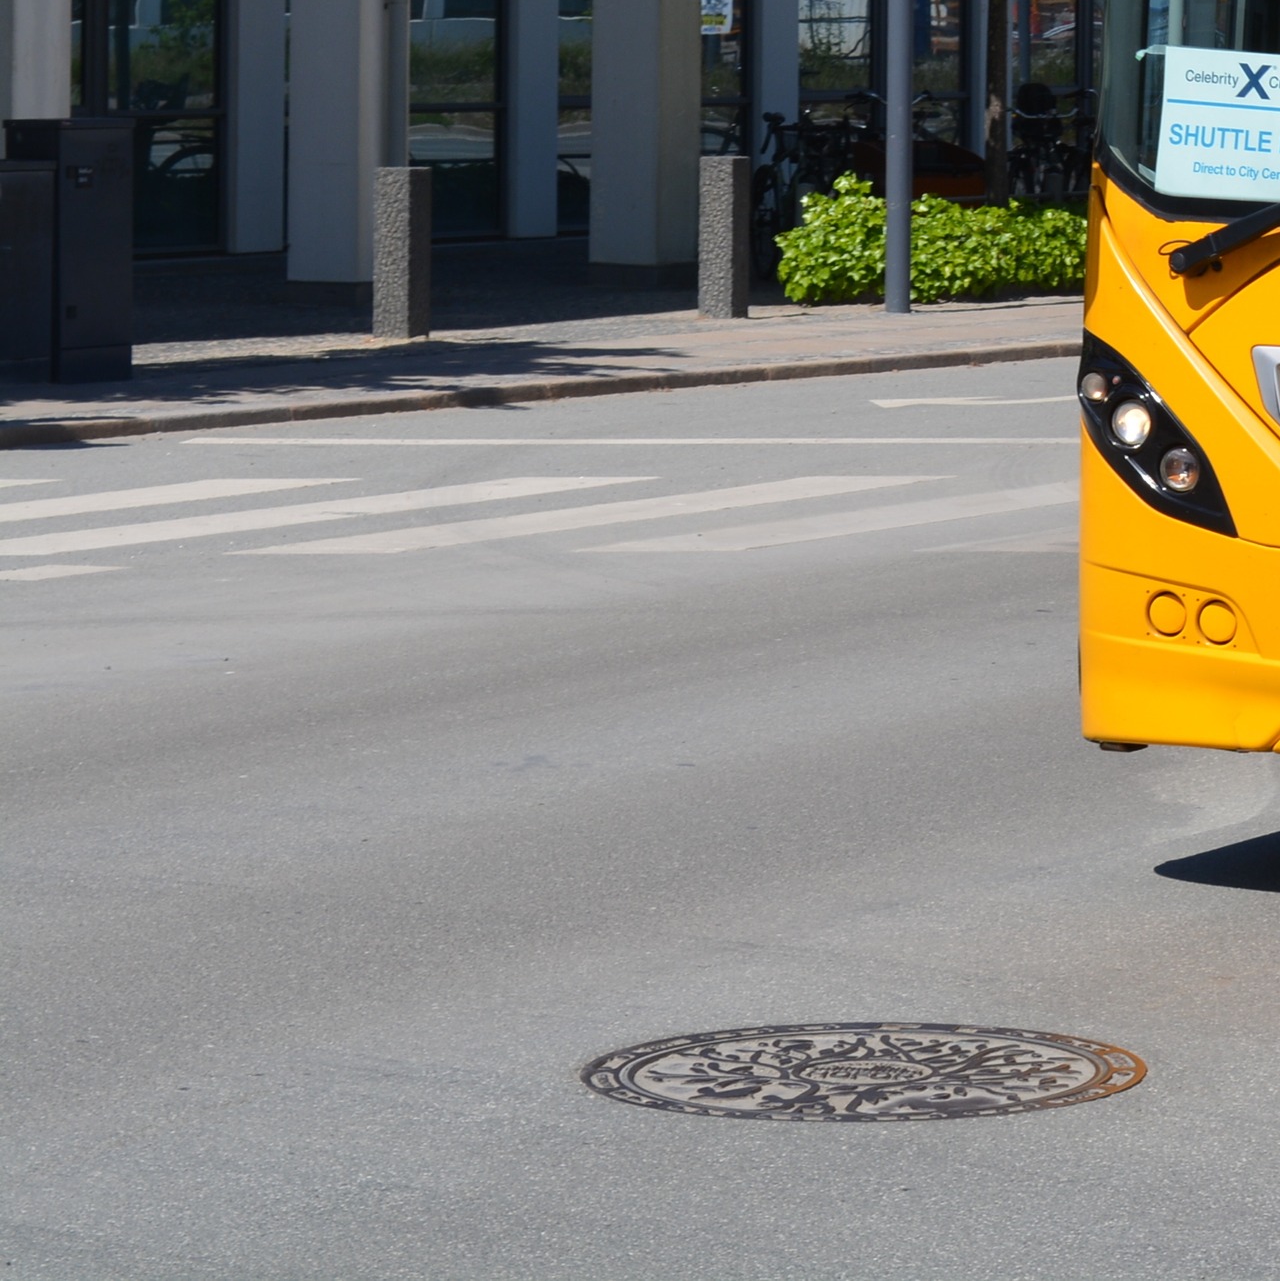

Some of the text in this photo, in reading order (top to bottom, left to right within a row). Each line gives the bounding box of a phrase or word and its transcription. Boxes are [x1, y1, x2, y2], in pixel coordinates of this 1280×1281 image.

[1185, 70, 1239, 88] Celebrity
[1236, 62, 1271, 100] X
[1169, 123, 1271, 153] SHUTTLE
[1193, 161, 1223, 175] Direct
[1225, 165, 1236, 176] to
[1238, 165, 1259, 181] City
